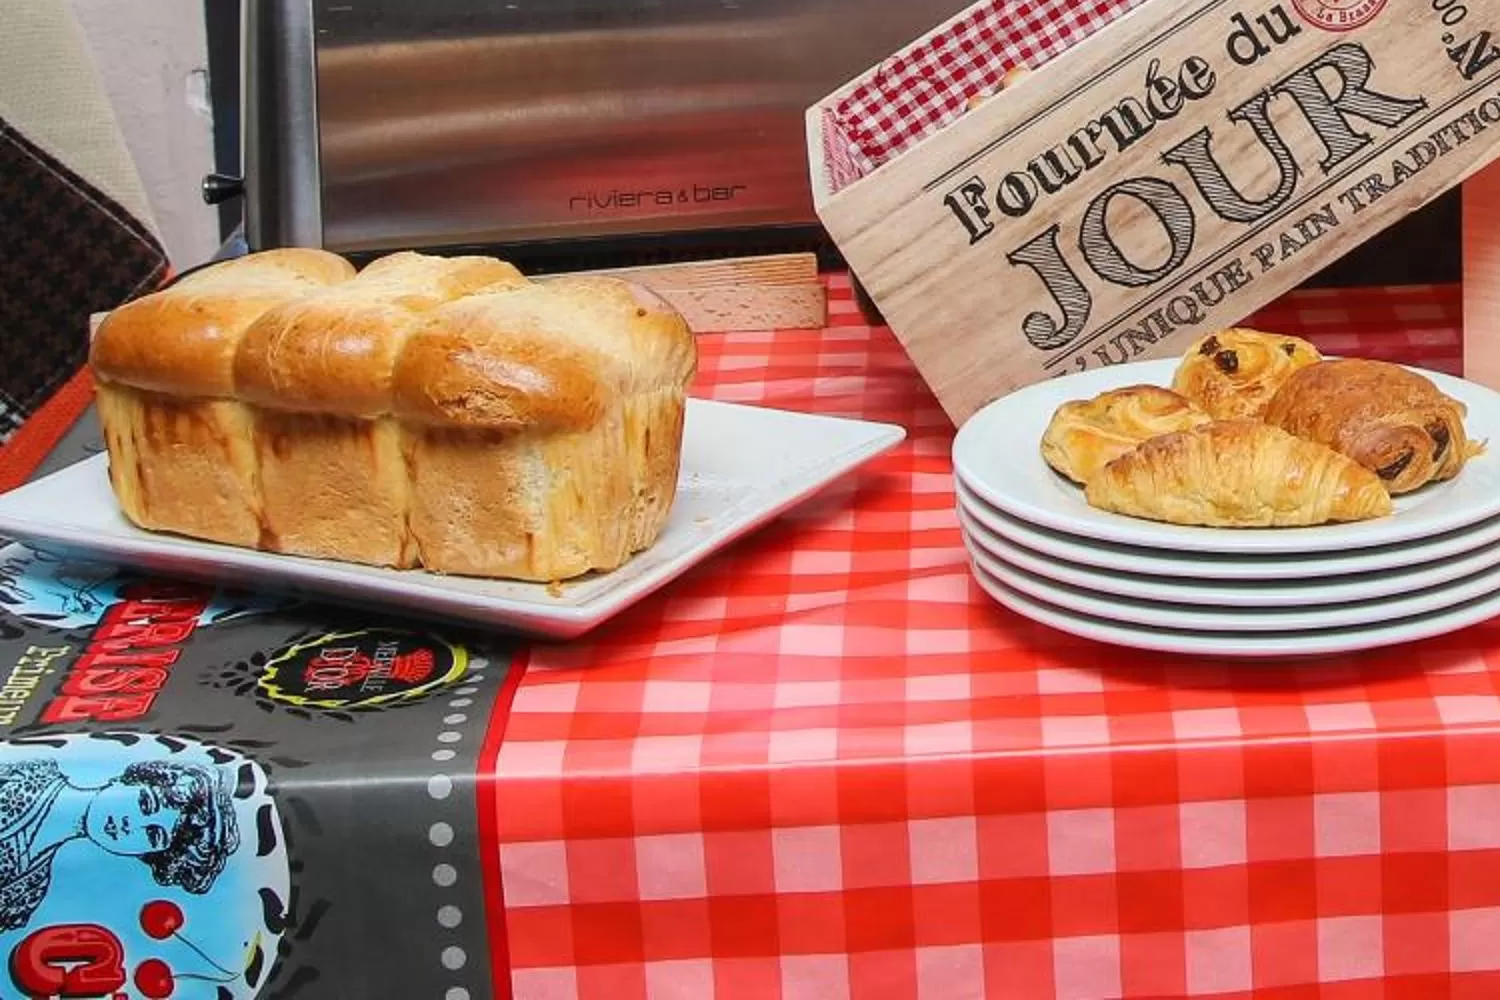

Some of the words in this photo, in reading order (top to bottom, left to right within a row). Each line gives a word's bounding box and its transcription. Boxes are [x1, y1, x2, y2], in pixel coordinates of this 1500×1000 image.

[943, 50, 1217, 245] Fournée
[1005, 43, 1429, 350] JOUR
[1052, 257, 1253, 378] 'UNIQUE
[1250, 209, 1340, 274] PAIN
[38, 578, 212, 724] ERISE
